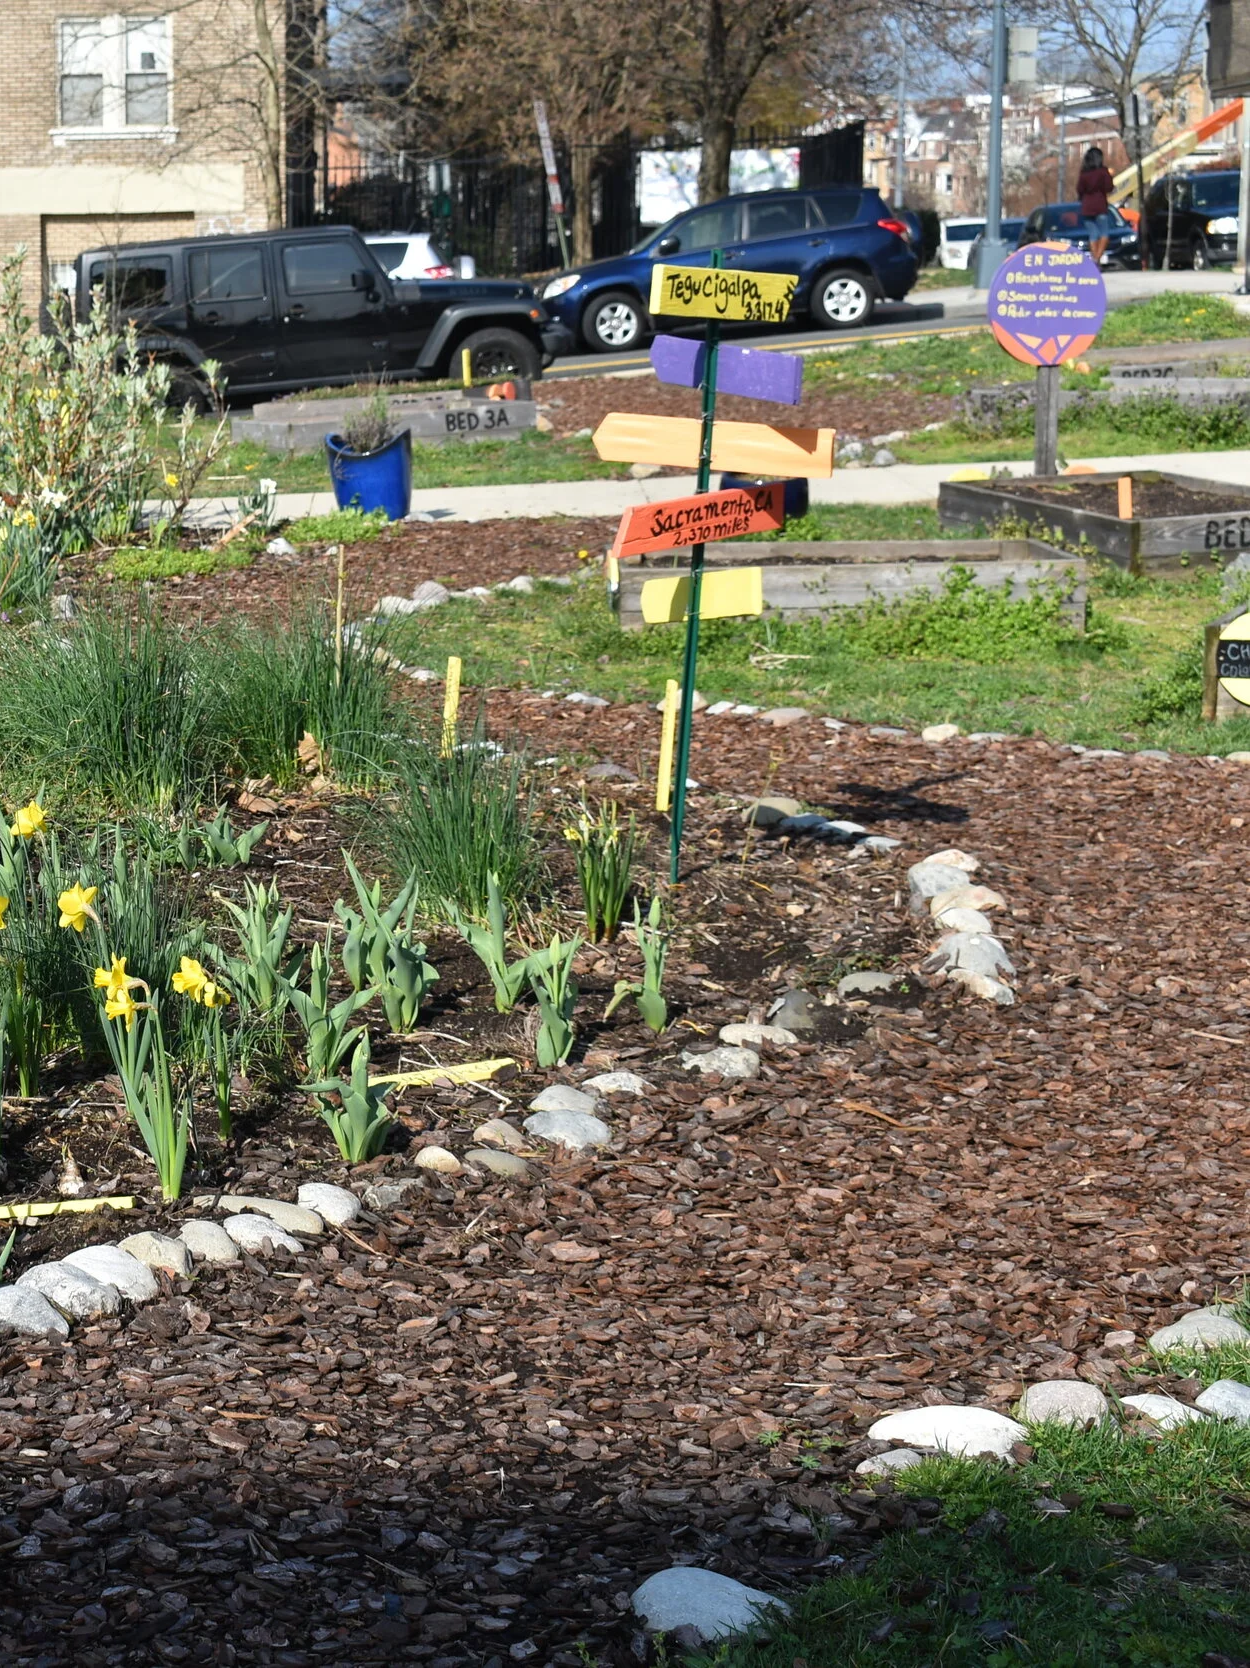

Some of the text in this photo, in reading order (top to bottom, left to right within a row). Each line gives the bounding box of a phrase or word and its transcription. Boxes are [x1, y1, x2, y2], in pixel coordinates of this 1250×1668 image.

[1024, 254, 1043, 267] EN
[445, 408, 510, 432] BED 3A
[713, 515, 750, 538] miles
[1204, 516, 1250, 549] BED
